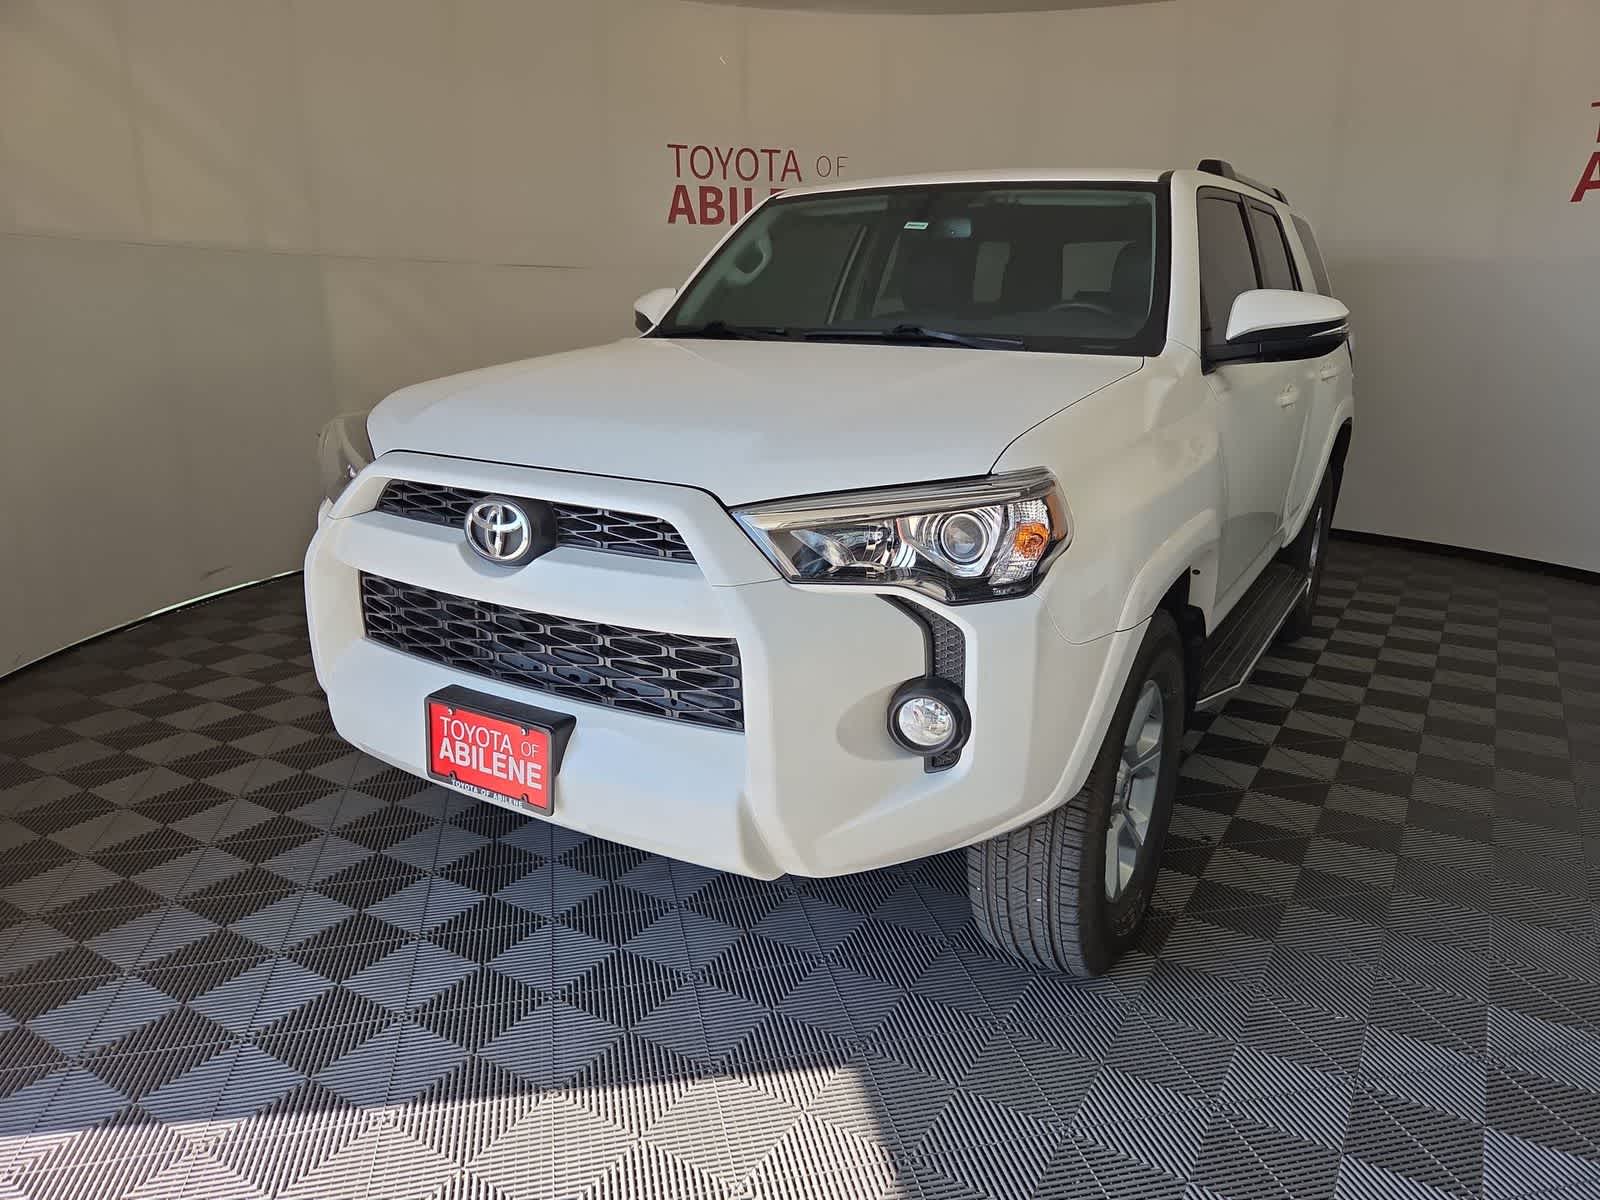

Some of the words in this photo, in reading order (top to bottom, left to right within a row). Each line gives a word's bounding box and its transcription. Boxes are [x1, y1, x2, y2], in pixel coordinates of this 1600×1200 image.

[667, 143, 802, 182] TOYOTA
[816, 155, 849, 177] OF
[667, 184, 787, 225] ABIL
[439, 716, 513, 755] TOYOTA
[520, 741, 539, 758] OF
[439, 737, 542, 790] ABILENE
[452, 779, 478, 794] TOYOTA
[480, 788, 489, 797] OF
